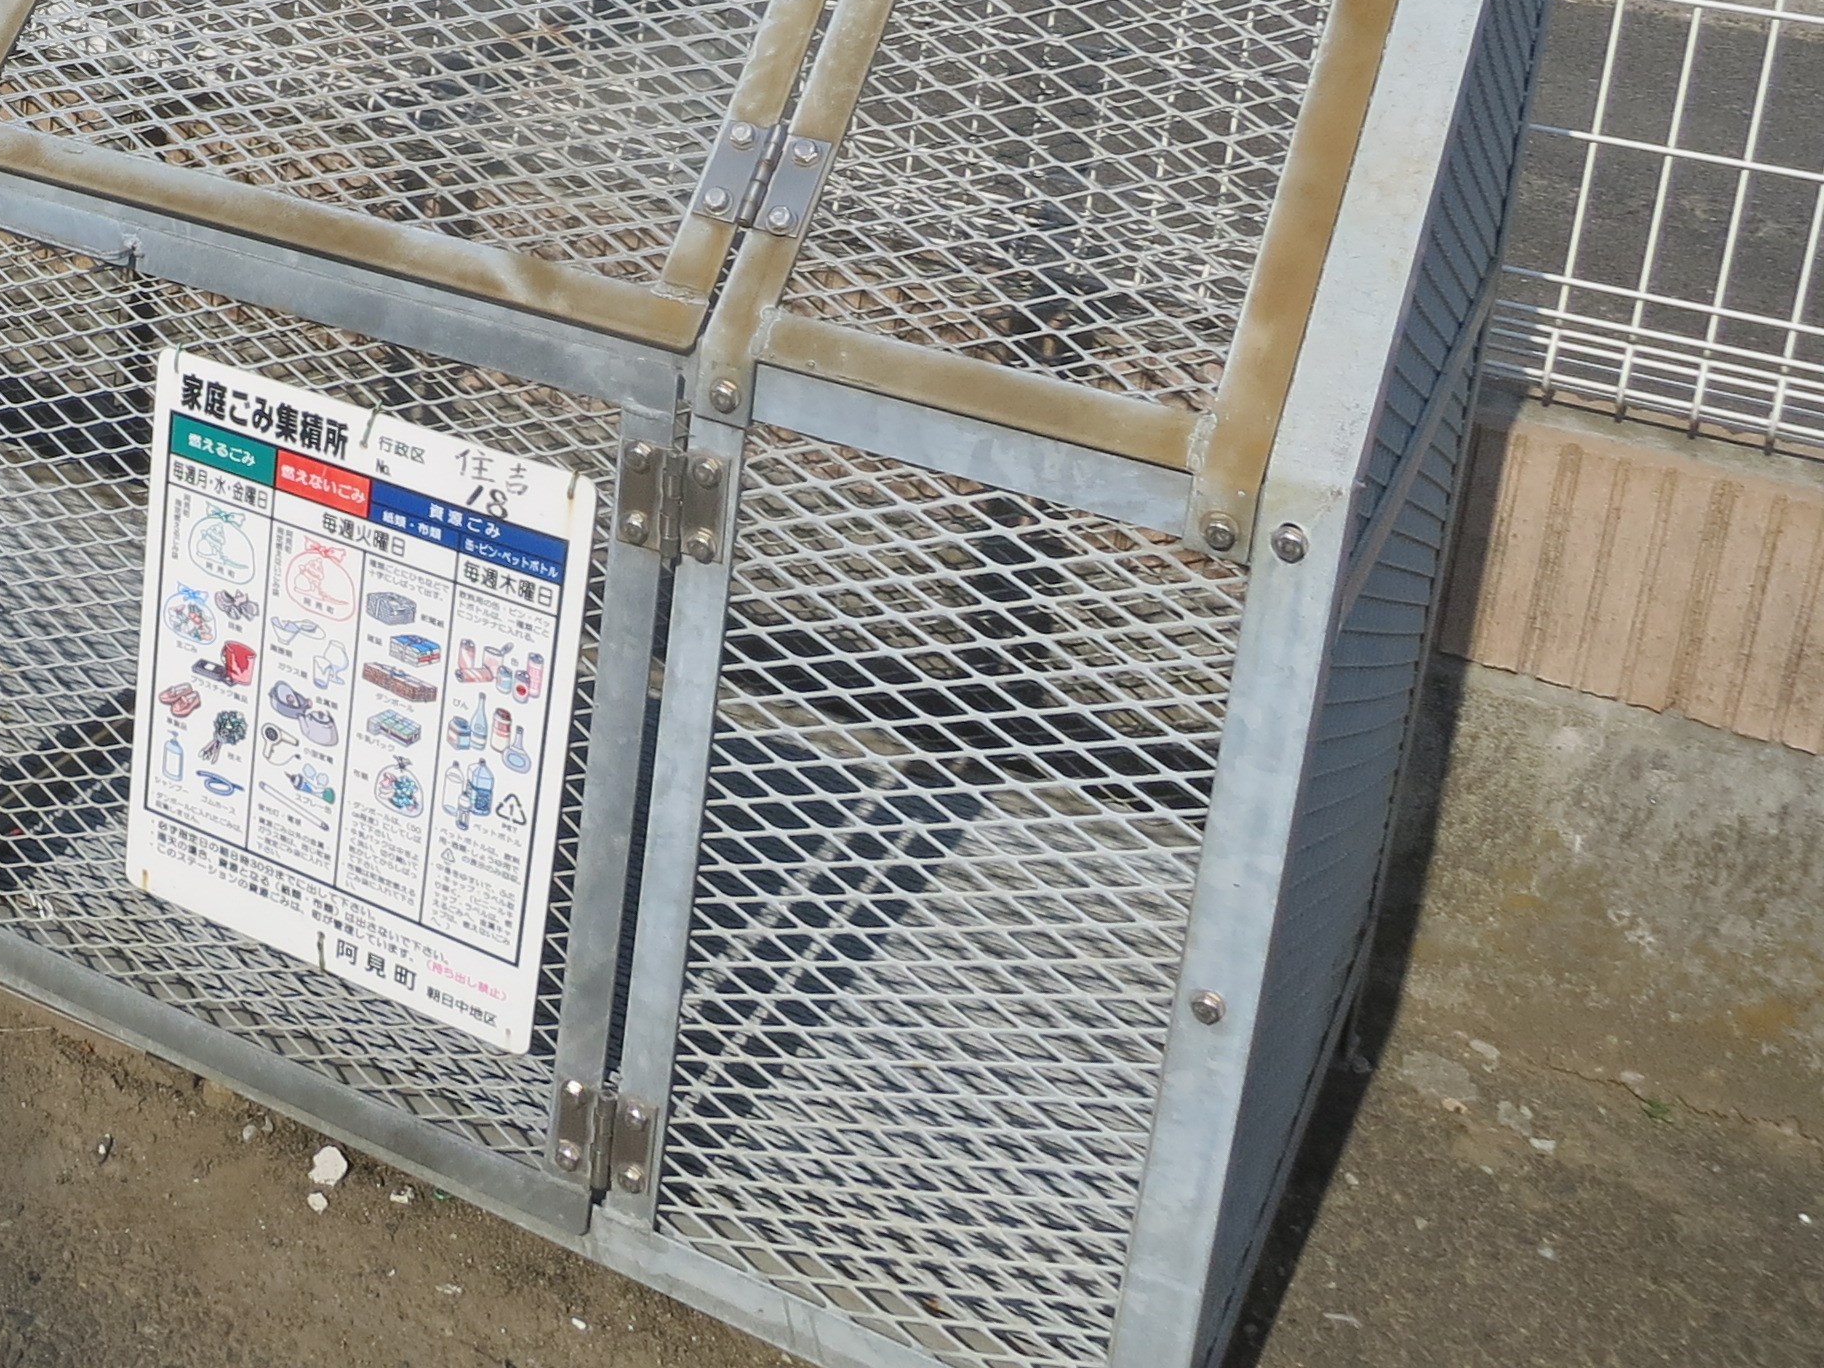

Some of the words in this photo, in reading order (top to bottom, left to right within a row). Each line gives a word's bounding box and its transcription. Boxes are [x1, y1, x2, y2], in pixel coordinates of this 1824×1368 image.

[180, 374, 349, 461] 家庭ごみ集積所
[187, 431, 256, 468] 燃えるごみ
[378, 434, 426, 464] 行政区
[172, 459, 268, 510] 毎週月・水・金曜日
[280, 463, 366, 505] 燃えないごみ
[455, 448, 529, 496] 住吉
[428, 501, 501, 540] 資源ごみ
[465, 484, 509, 520] 18
[321, 510, 406, 558] 毎週火曜日
[381, 509, 442, 541] 紙類・布類
[461, 559, 553, 609] 毎週木曜日
[335, 937, 417, 992] 阿見町
[425, 984, 498, 1028] 朝日中地区
